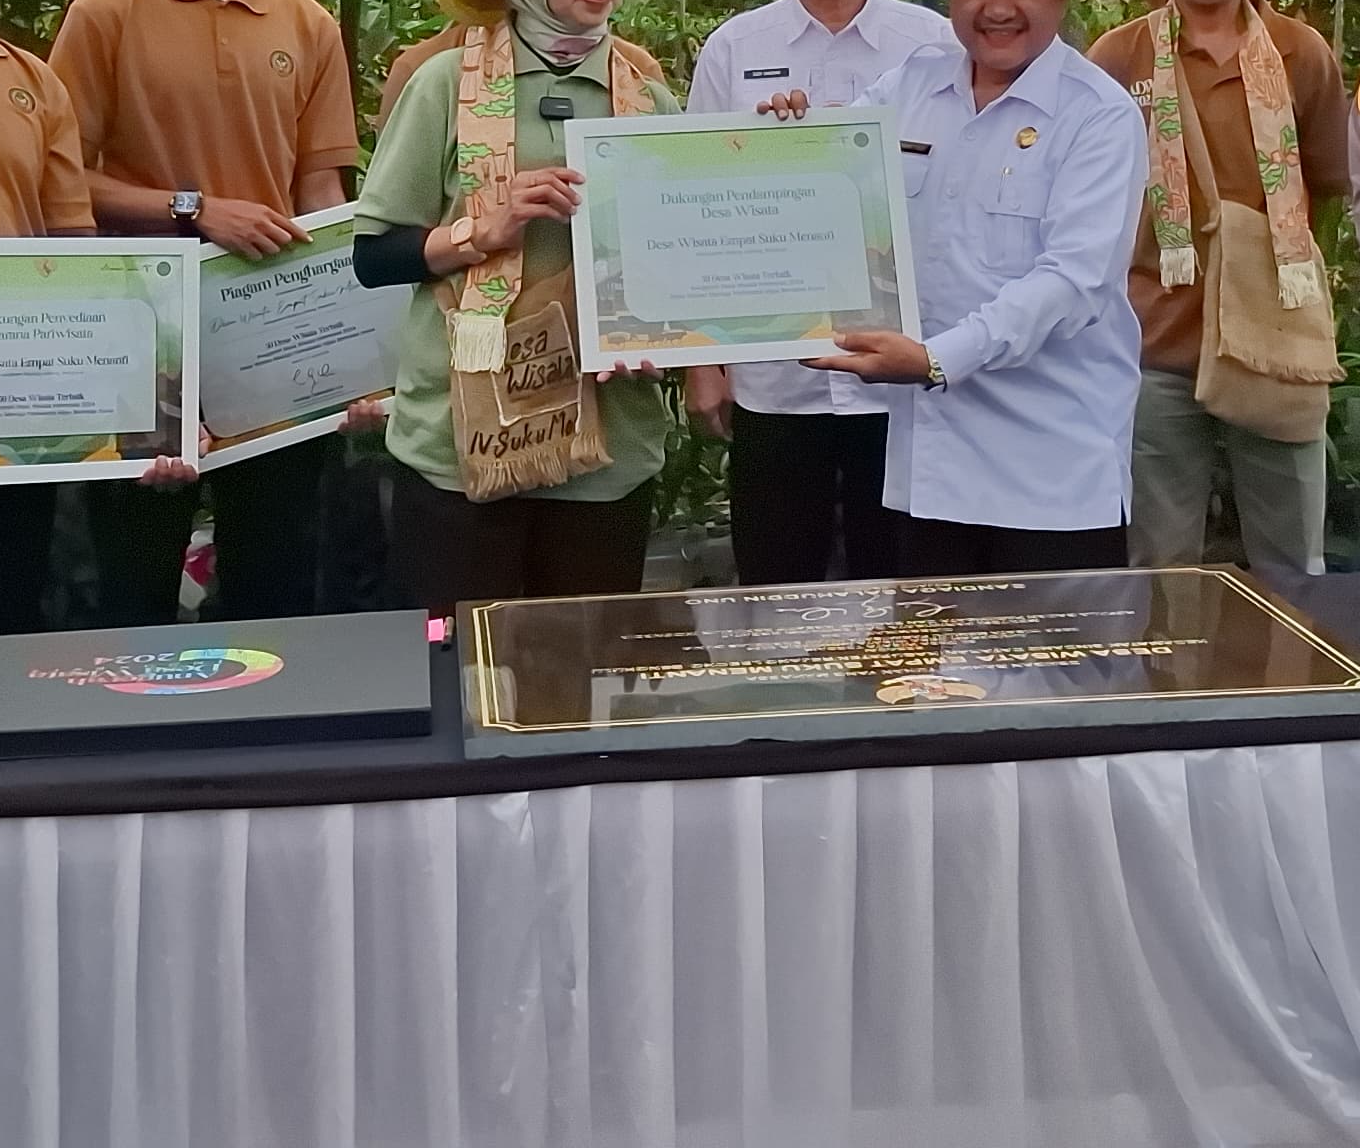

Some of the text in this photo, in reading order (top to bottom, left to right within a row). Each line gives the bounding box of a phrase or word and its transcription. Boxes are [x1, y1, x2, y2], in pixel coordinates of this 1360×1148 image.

[661, 187, 816, 206] Dukungan Pendampingan
[701, 204, 780, 219] Desa Wisata
[647, 239, 674, 250] Desa
[678, 236, 718, 248] Wisata
[758, 232, 787, 244] Suku
[220, 256, 353, 302] Piagam Penghargaa
[41, 311, 106, 325] Penyediaan
[33, 327, 94, 340] Pariwisata
[508, 329, 548, 360] esa
[57, 355, 84, 367] Suku
[683, 597, 735, 605] UNO
[93, 651, 176, 665] 2024
[640, 646, 1173, 680] DESA WISATA EMPAT SUKU MENANTI
